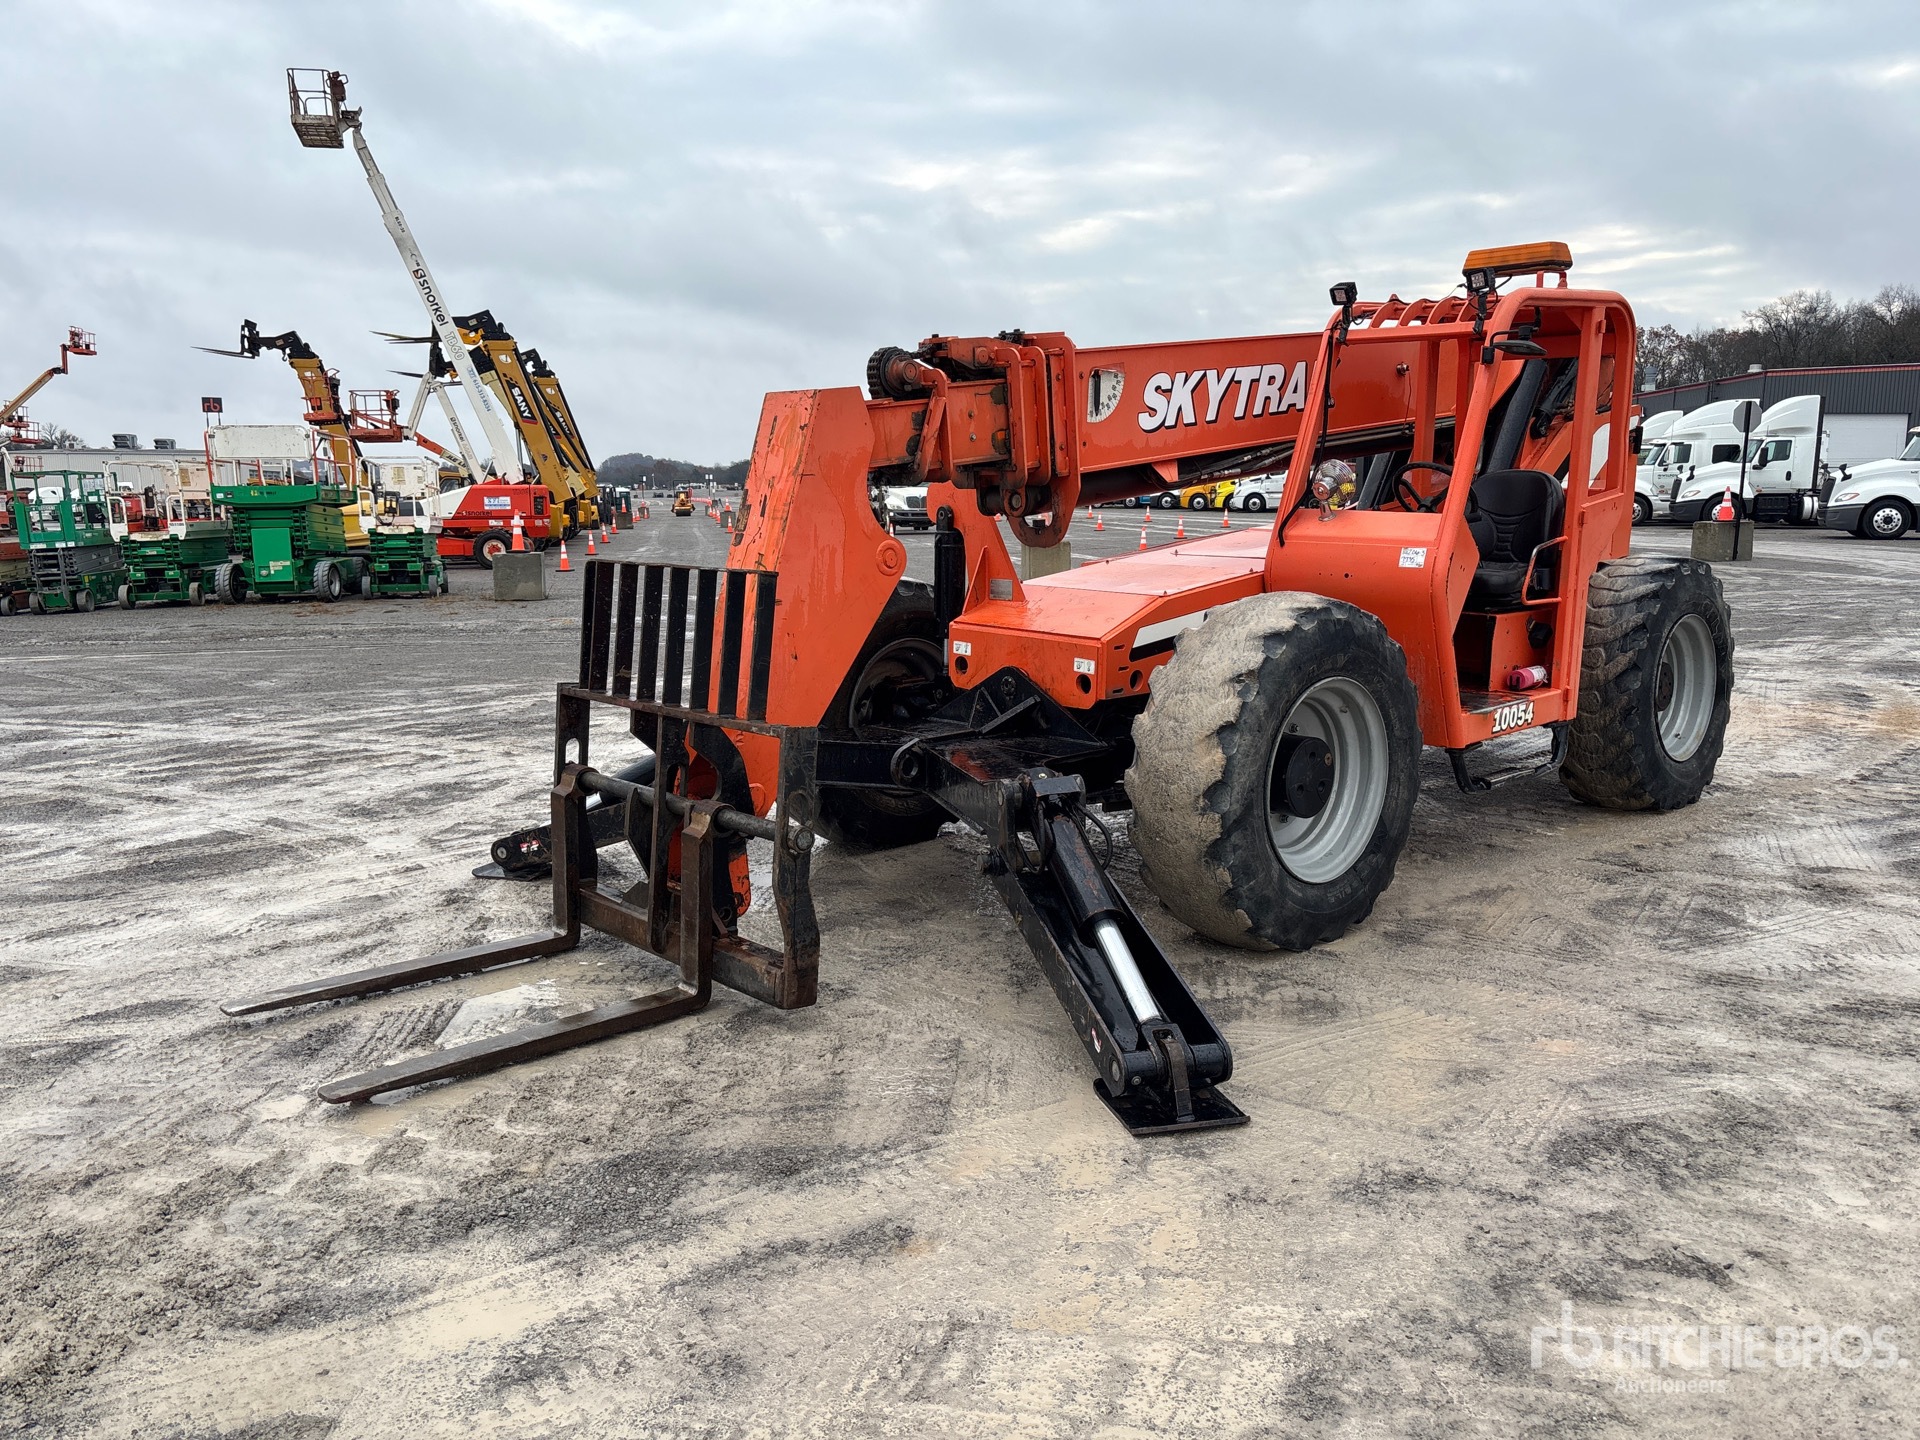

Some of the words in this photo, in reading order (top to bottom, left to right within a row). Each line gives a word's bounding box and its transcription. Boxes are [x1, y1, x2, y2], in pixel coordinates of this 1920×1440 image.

[418, 278, 449, 327] snorkel
[444, 331, 465, 361] TB60
[204, 398, 220, 412] rb
[511, 387, 532, 419] SANY
[1137, 360, 1317, 434] SKYTRA
[555, 411, 570, 434] SANY
[1492, 701, 1535, 733] 10054
